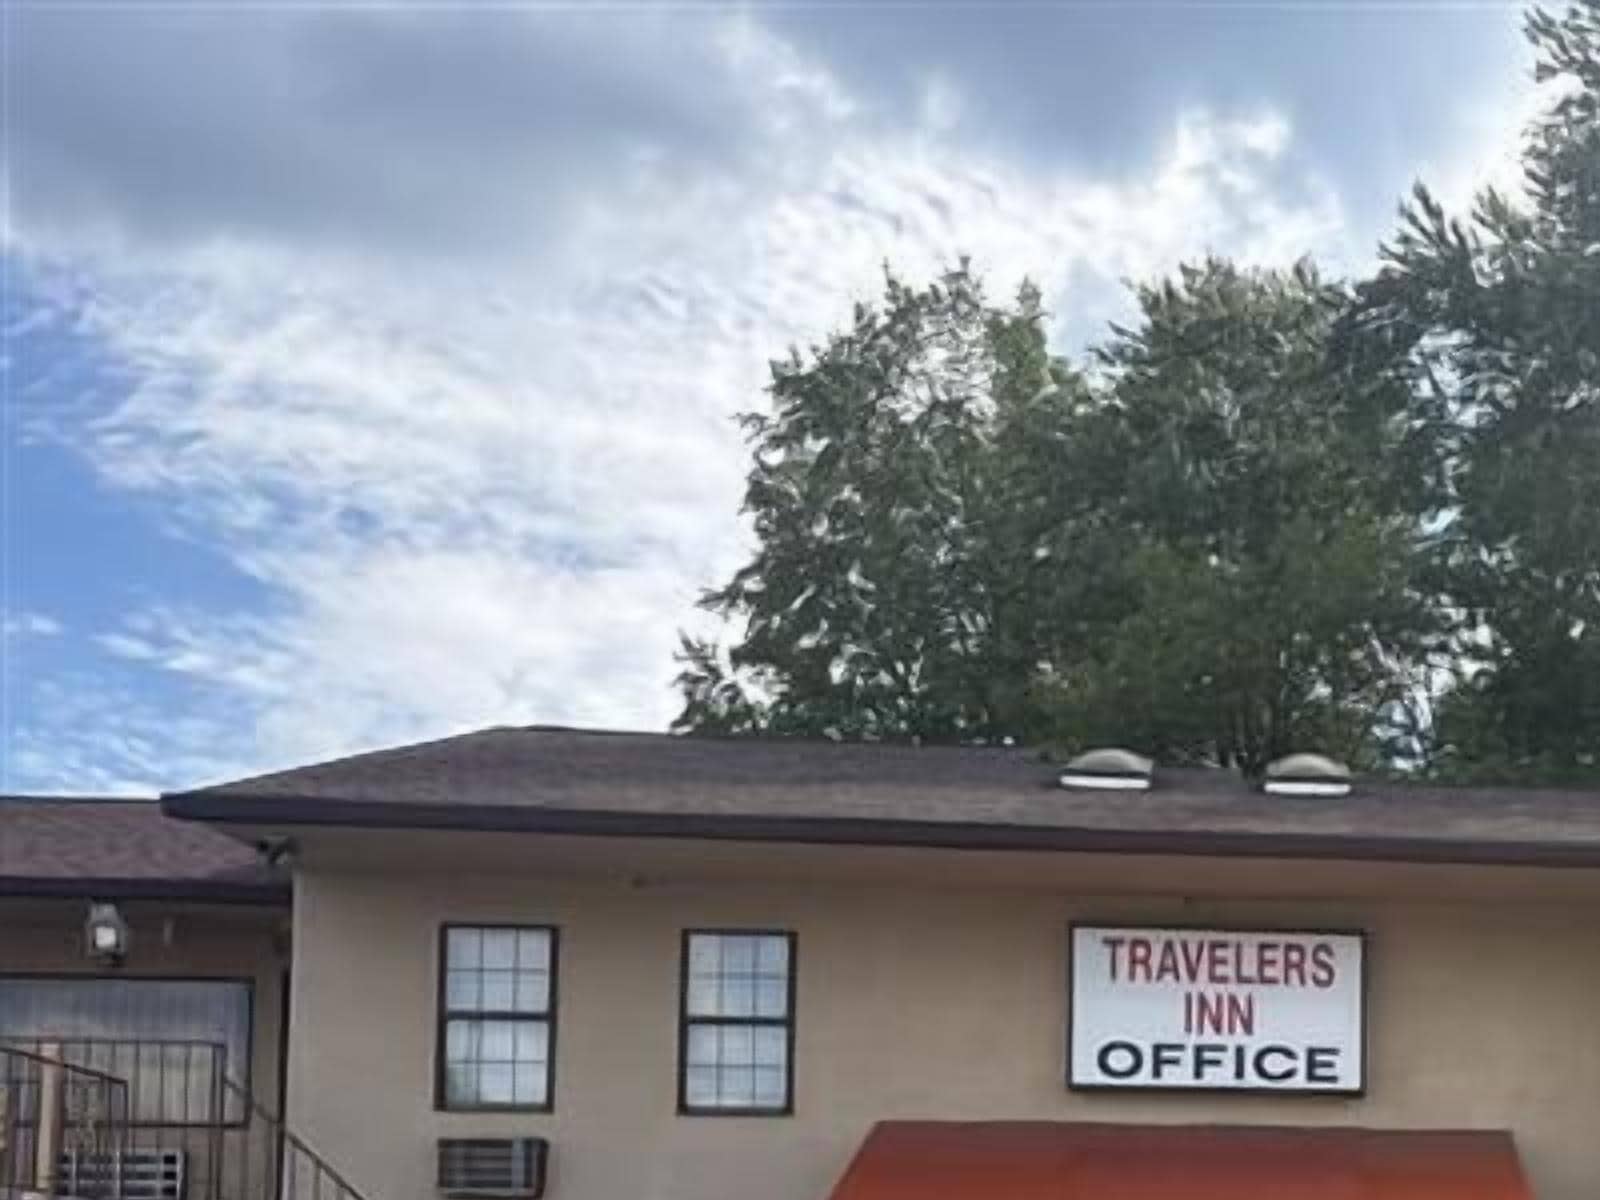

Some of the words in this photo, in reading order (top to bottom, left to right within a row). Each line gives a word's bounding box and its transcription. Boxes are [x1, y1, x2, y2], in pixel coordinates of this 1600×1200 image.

[1102, 936, 1336, 988] TRAVELERS
[1183, 992, 1254, 1036] INN
[1096, 1040, 1340, 1083] OFFICE
